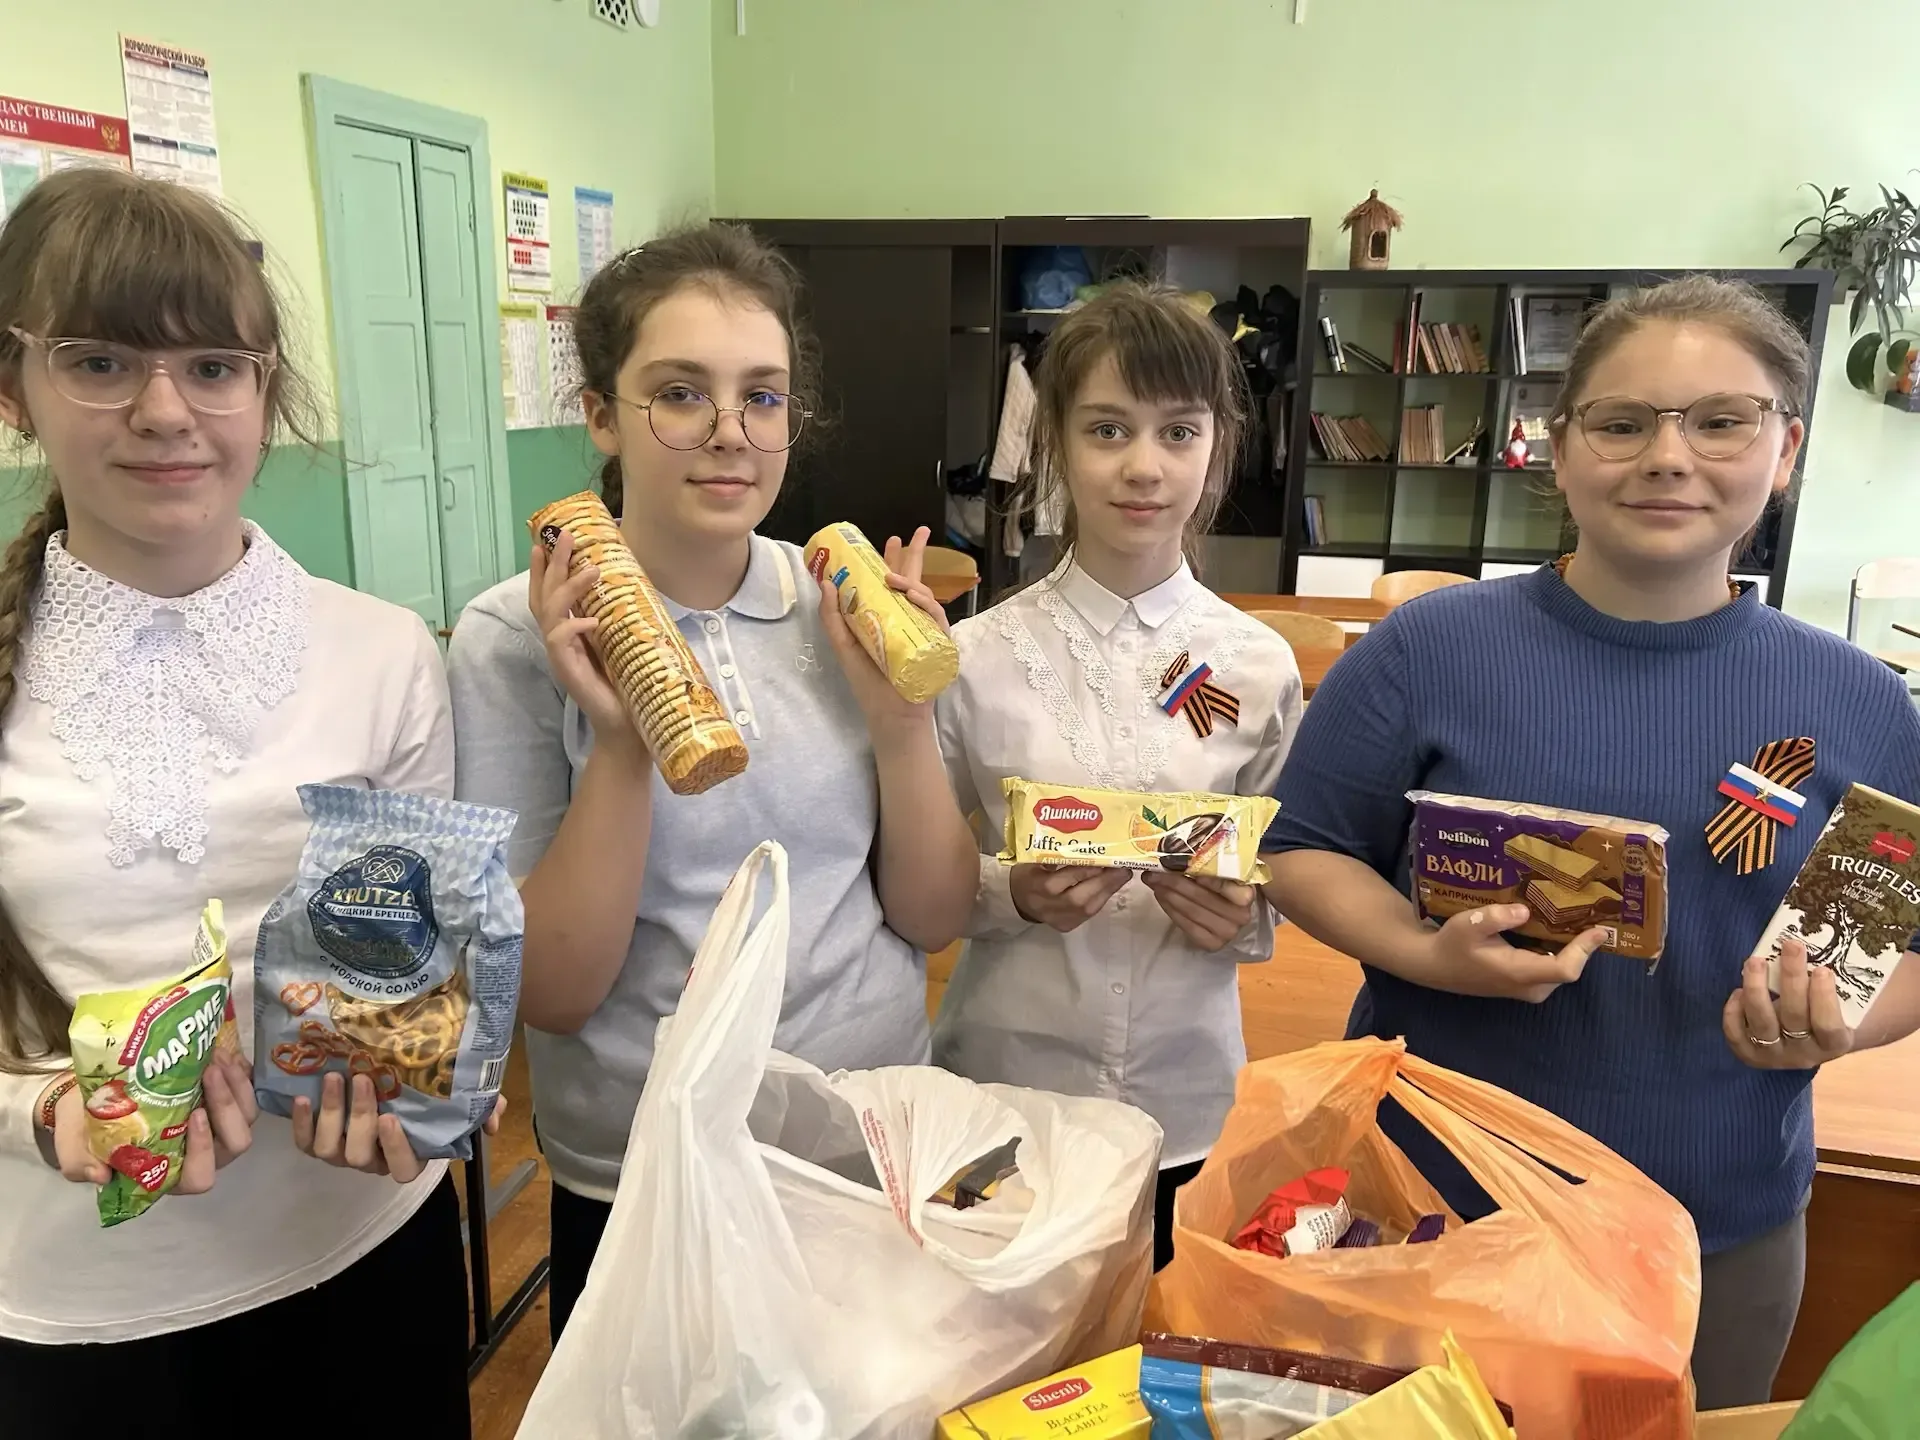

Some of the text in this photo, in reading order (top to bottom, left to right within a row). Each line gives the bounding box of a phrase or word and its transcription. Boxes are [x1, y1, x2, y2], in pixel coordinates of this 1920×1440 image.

[125, 37, 182, 63] МОРФОЛОГИЧЕСКИЙ
[184, 53, 206, 68] РАЗБОР
[1025, 834, 1106, 855] Jaffa Cake
[1437, 830, 1490, 848] Delibon
[1425, 854, 1503, 886] ВАФЛИ
[1828, 854, 1920, 905] TRUFFLES
[326, 903, 373, 917] НЕМЕЦКИЙ
[329, 962, 382, 994] МОРСКОЙ
[385, 973, 430, 994] СОЛЬЮ
[142, 989, 221, 1079] МАРМЕ
[140, 1159, 169, 1183] 250
[1028, 1381, 1084, 1407] Shenly
